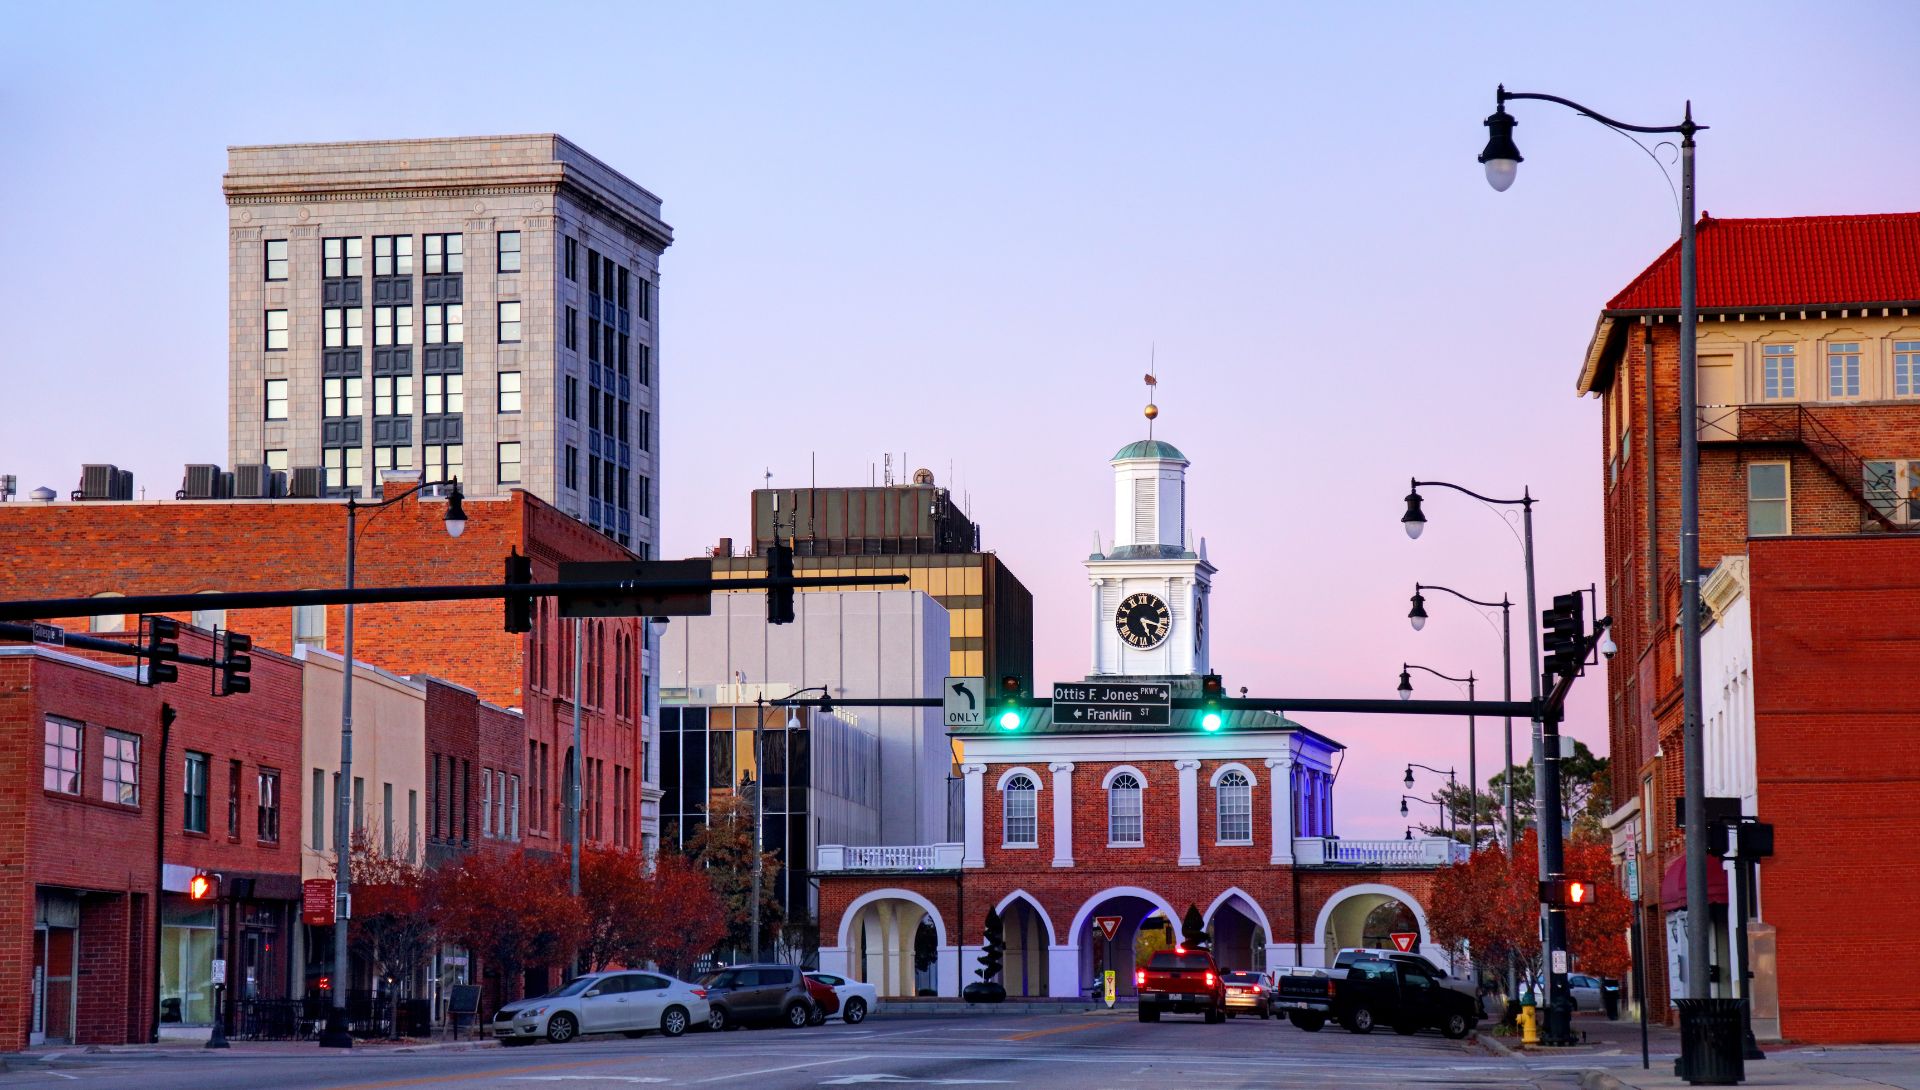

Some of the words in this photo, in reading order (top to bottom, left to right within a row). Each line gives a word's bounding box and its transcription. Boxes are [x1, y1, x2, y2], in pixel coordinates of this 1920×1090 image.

[1138, 596, 1148, 604] XII
[1055, 688, 1085, 700] Ottis
[1089, 689, 1096, 700] F.
[1102, 689, 1139, 701] Jones
[950, 713, 979, 722] ONLY
[1088, 709, 1132, 720] Franklin
